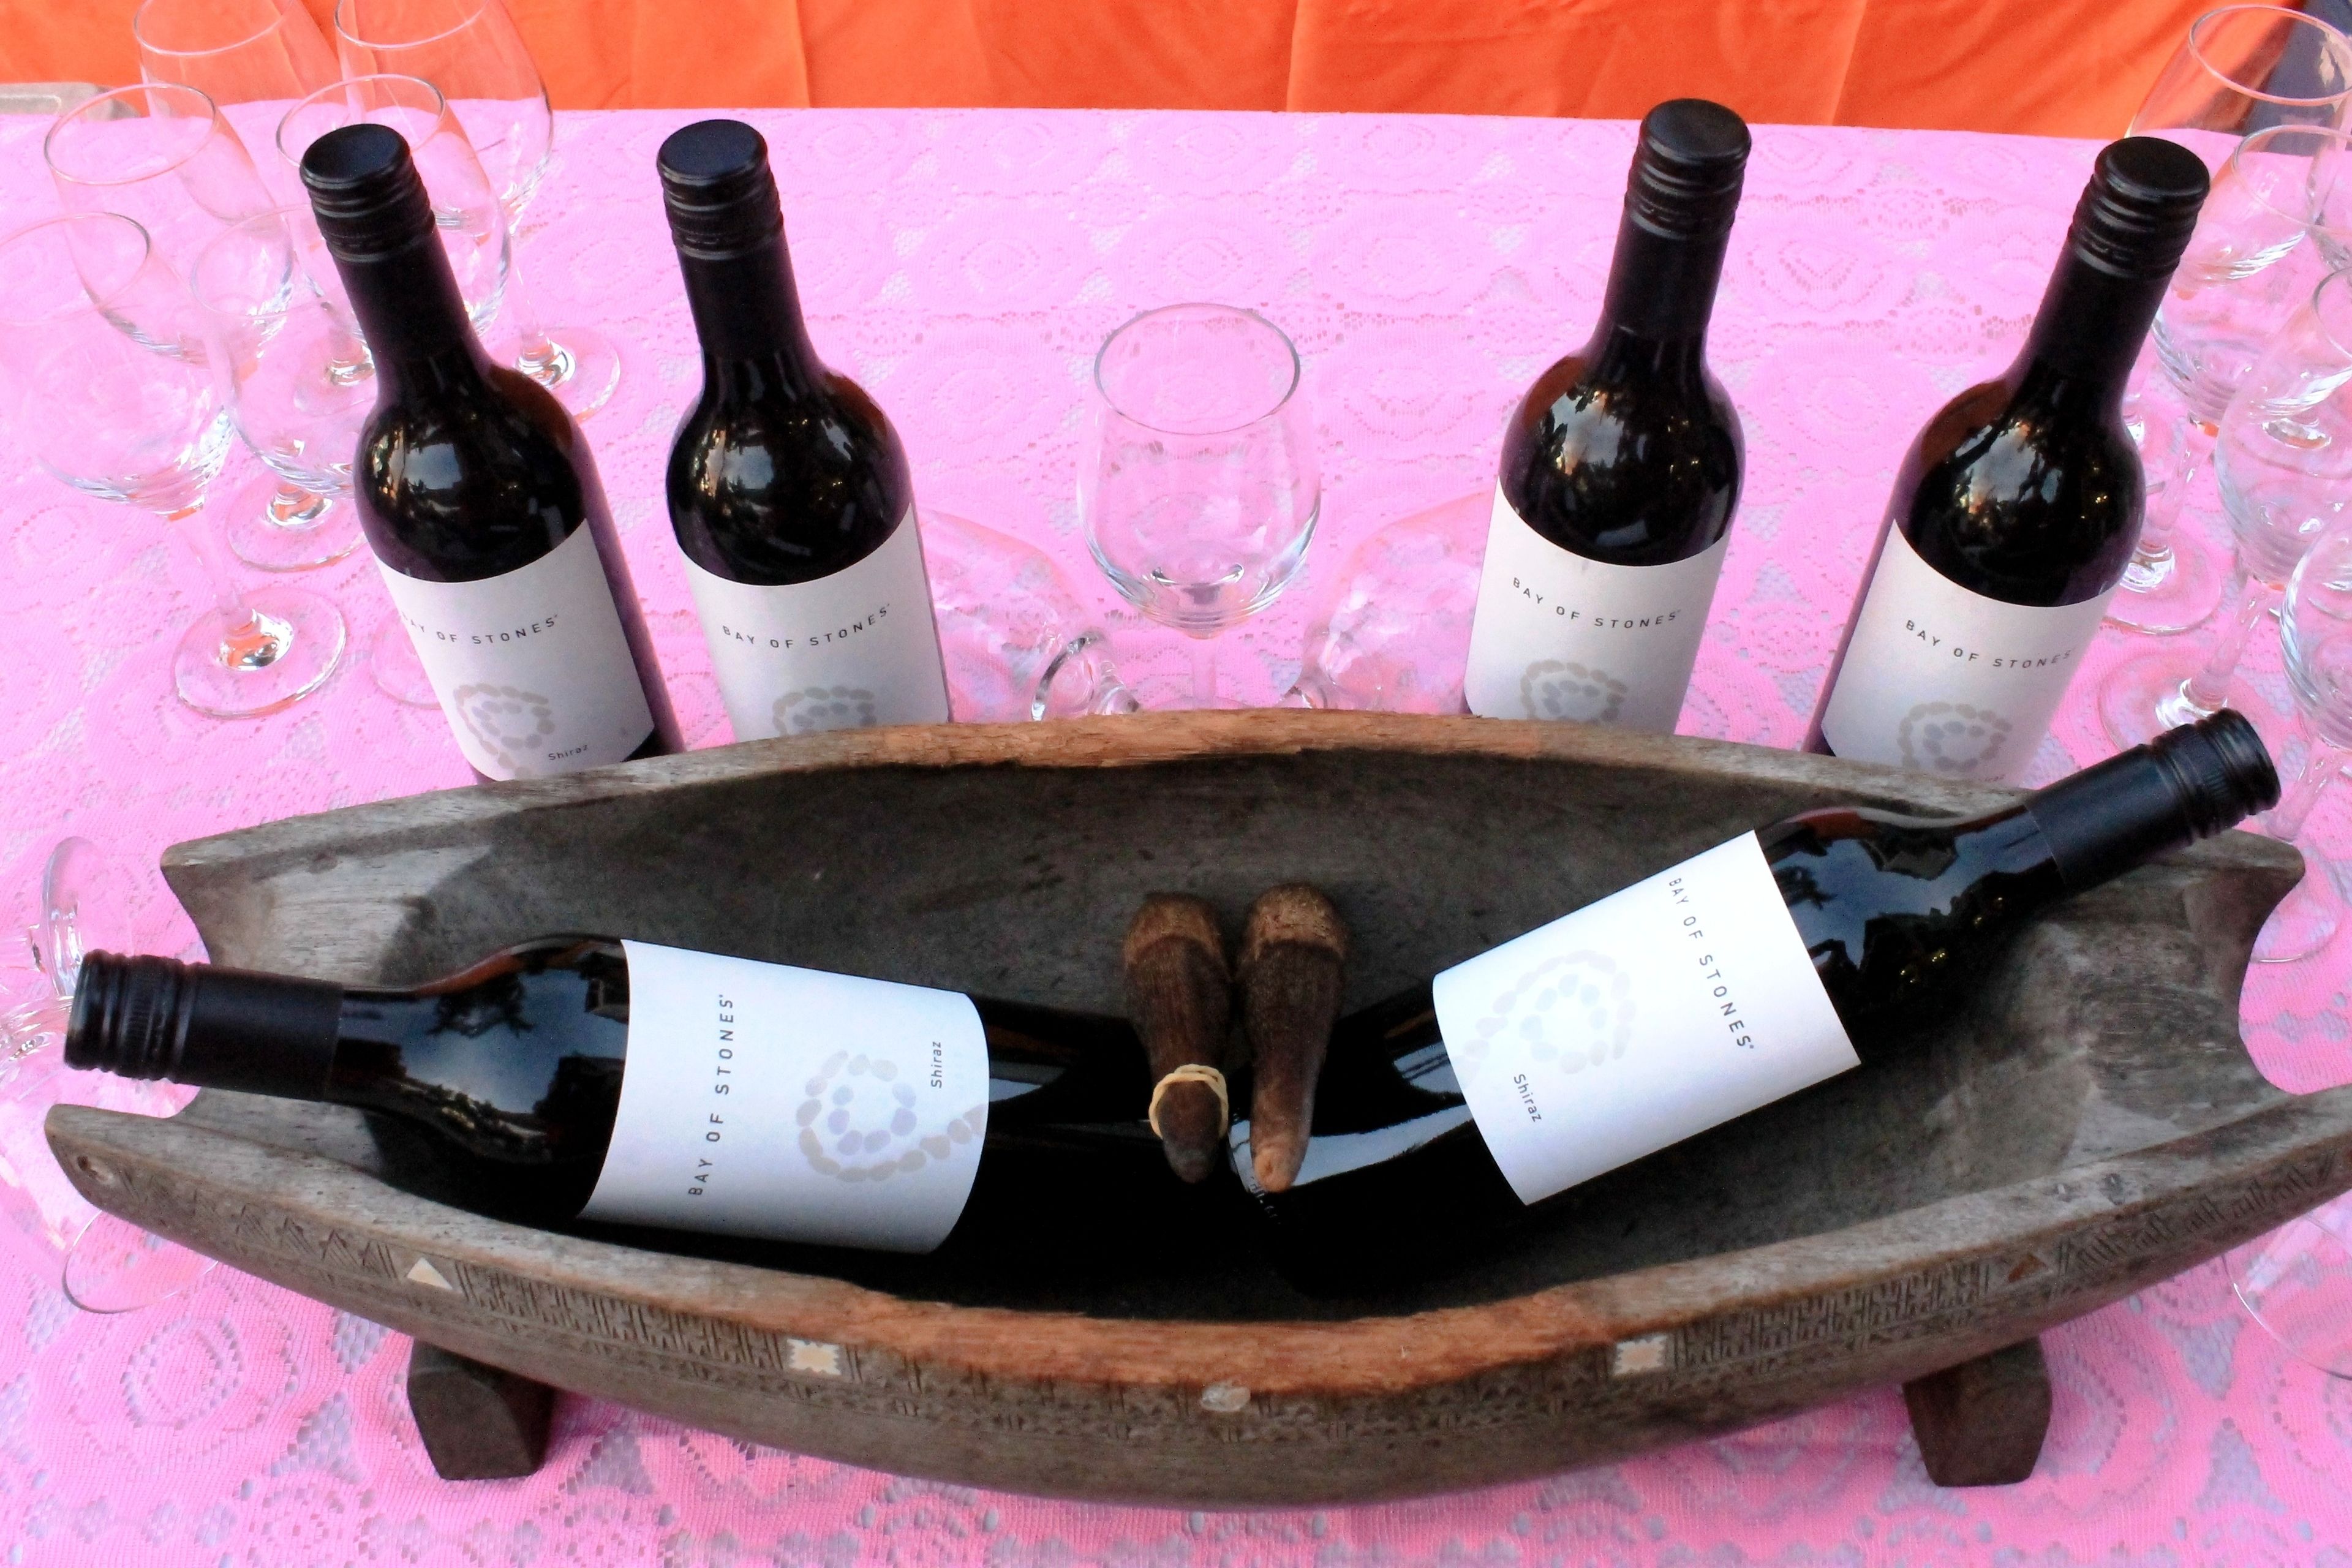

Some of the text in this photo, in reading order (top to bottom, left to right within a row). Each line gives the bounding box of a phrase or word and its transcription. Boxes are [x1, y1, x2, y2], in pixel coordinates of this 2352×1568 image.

[1513, 577, 1544, 604] BAY
[1556, 606, 1580, 620] OF
[436, 631, 458, 643] OF
[722, 625, 755, 644] BAY
[770, 639, 794, 649] OF
[1905, 620, 1940, 647] BAY
[1953, 647, 1980, 662] OF
[548, 744, 589, 761] Shiraz
[1668, 877, 1689, 906] BAY
[1683, 916, 1703, 941] OF
[930, 1041, 943, 1089] Shiraz
[1513, 1073, 1542, 1123] Shiraz
[688, 1158, 714, 1196] BAY
[706, 1112, 725, 1143] OF
